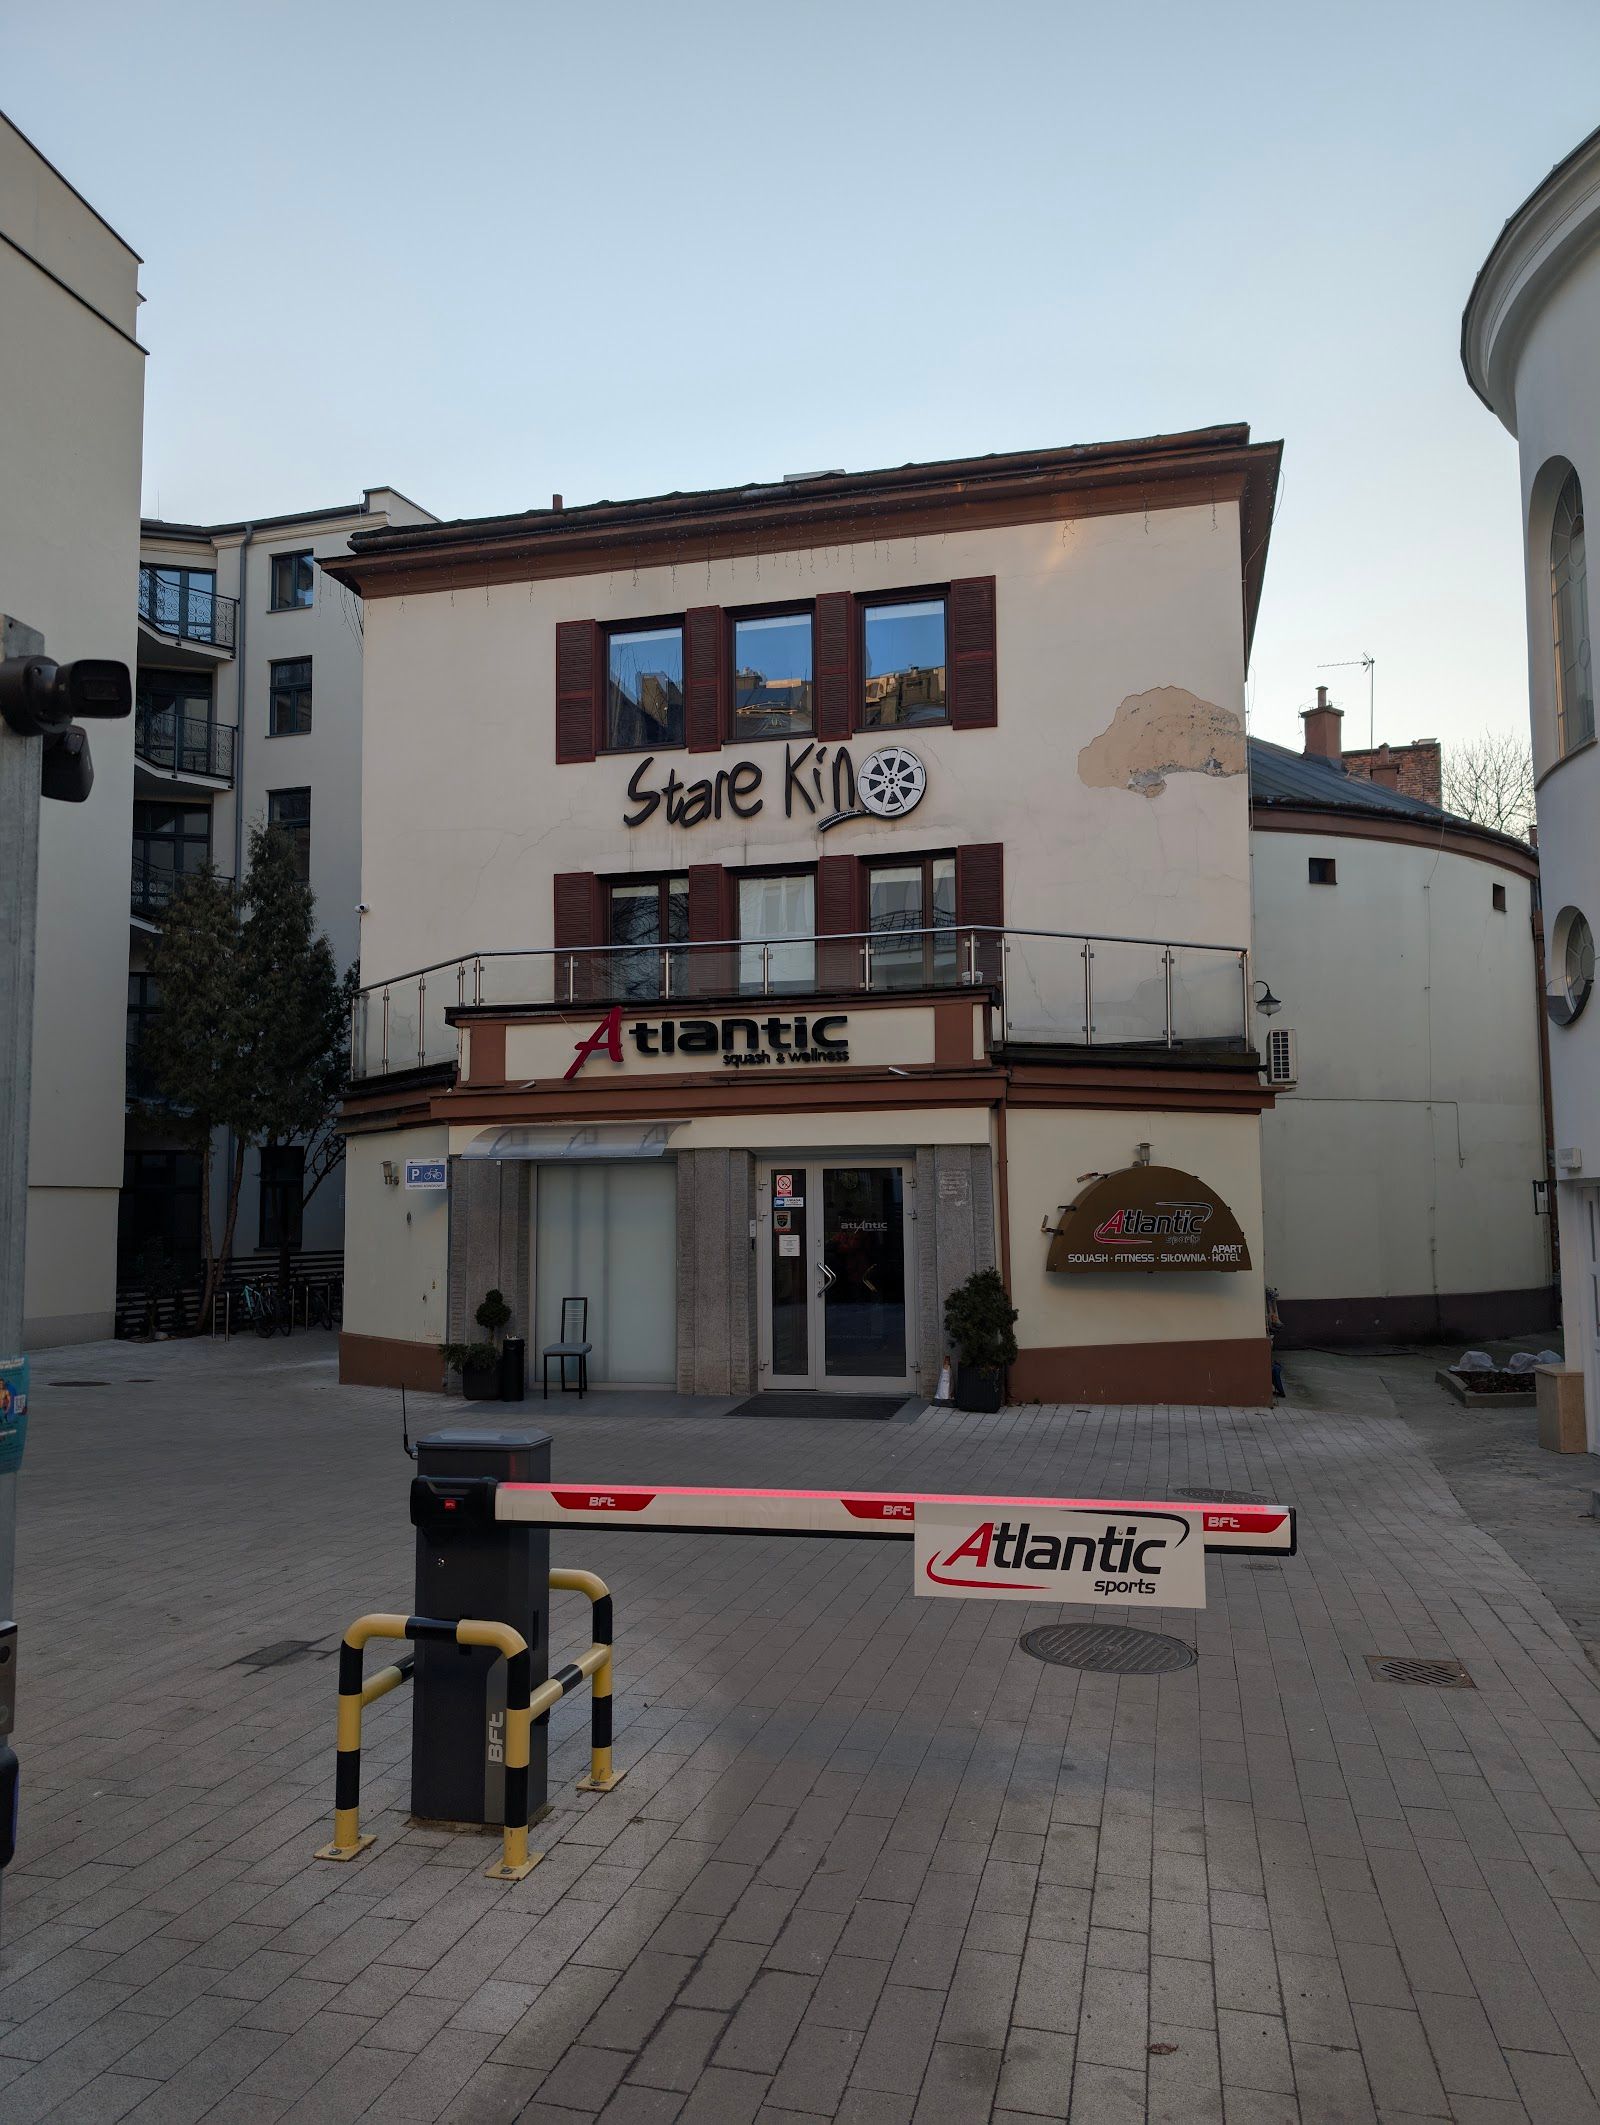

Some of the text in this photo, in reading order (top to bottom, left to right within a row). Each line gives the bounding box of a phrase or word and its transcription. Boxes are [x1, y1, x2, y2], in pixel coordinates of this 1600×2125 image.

[624, 756, 763, 827] Stare
[563, 1005, 849, 1080] Atlantic
[722, 1047, 850, 1069] squash & wellness
[411, 1168, 420, 1181] P
[1099, 1209, 1204, 1234] Atlantic
[1166, 1234, 1201, 1245] sports
[1211, 1244, 1243, 1254] APART
[1067, 1253, 1109, 1263] SQUASH
[1114, 1253, 1155, 1263] FITNESS
[1212, 1253, 1241, 1262] HOTEL
[942, 1522, 1167, 1575] Atlantic
[1094, 1578, 1156, 1596] sports
